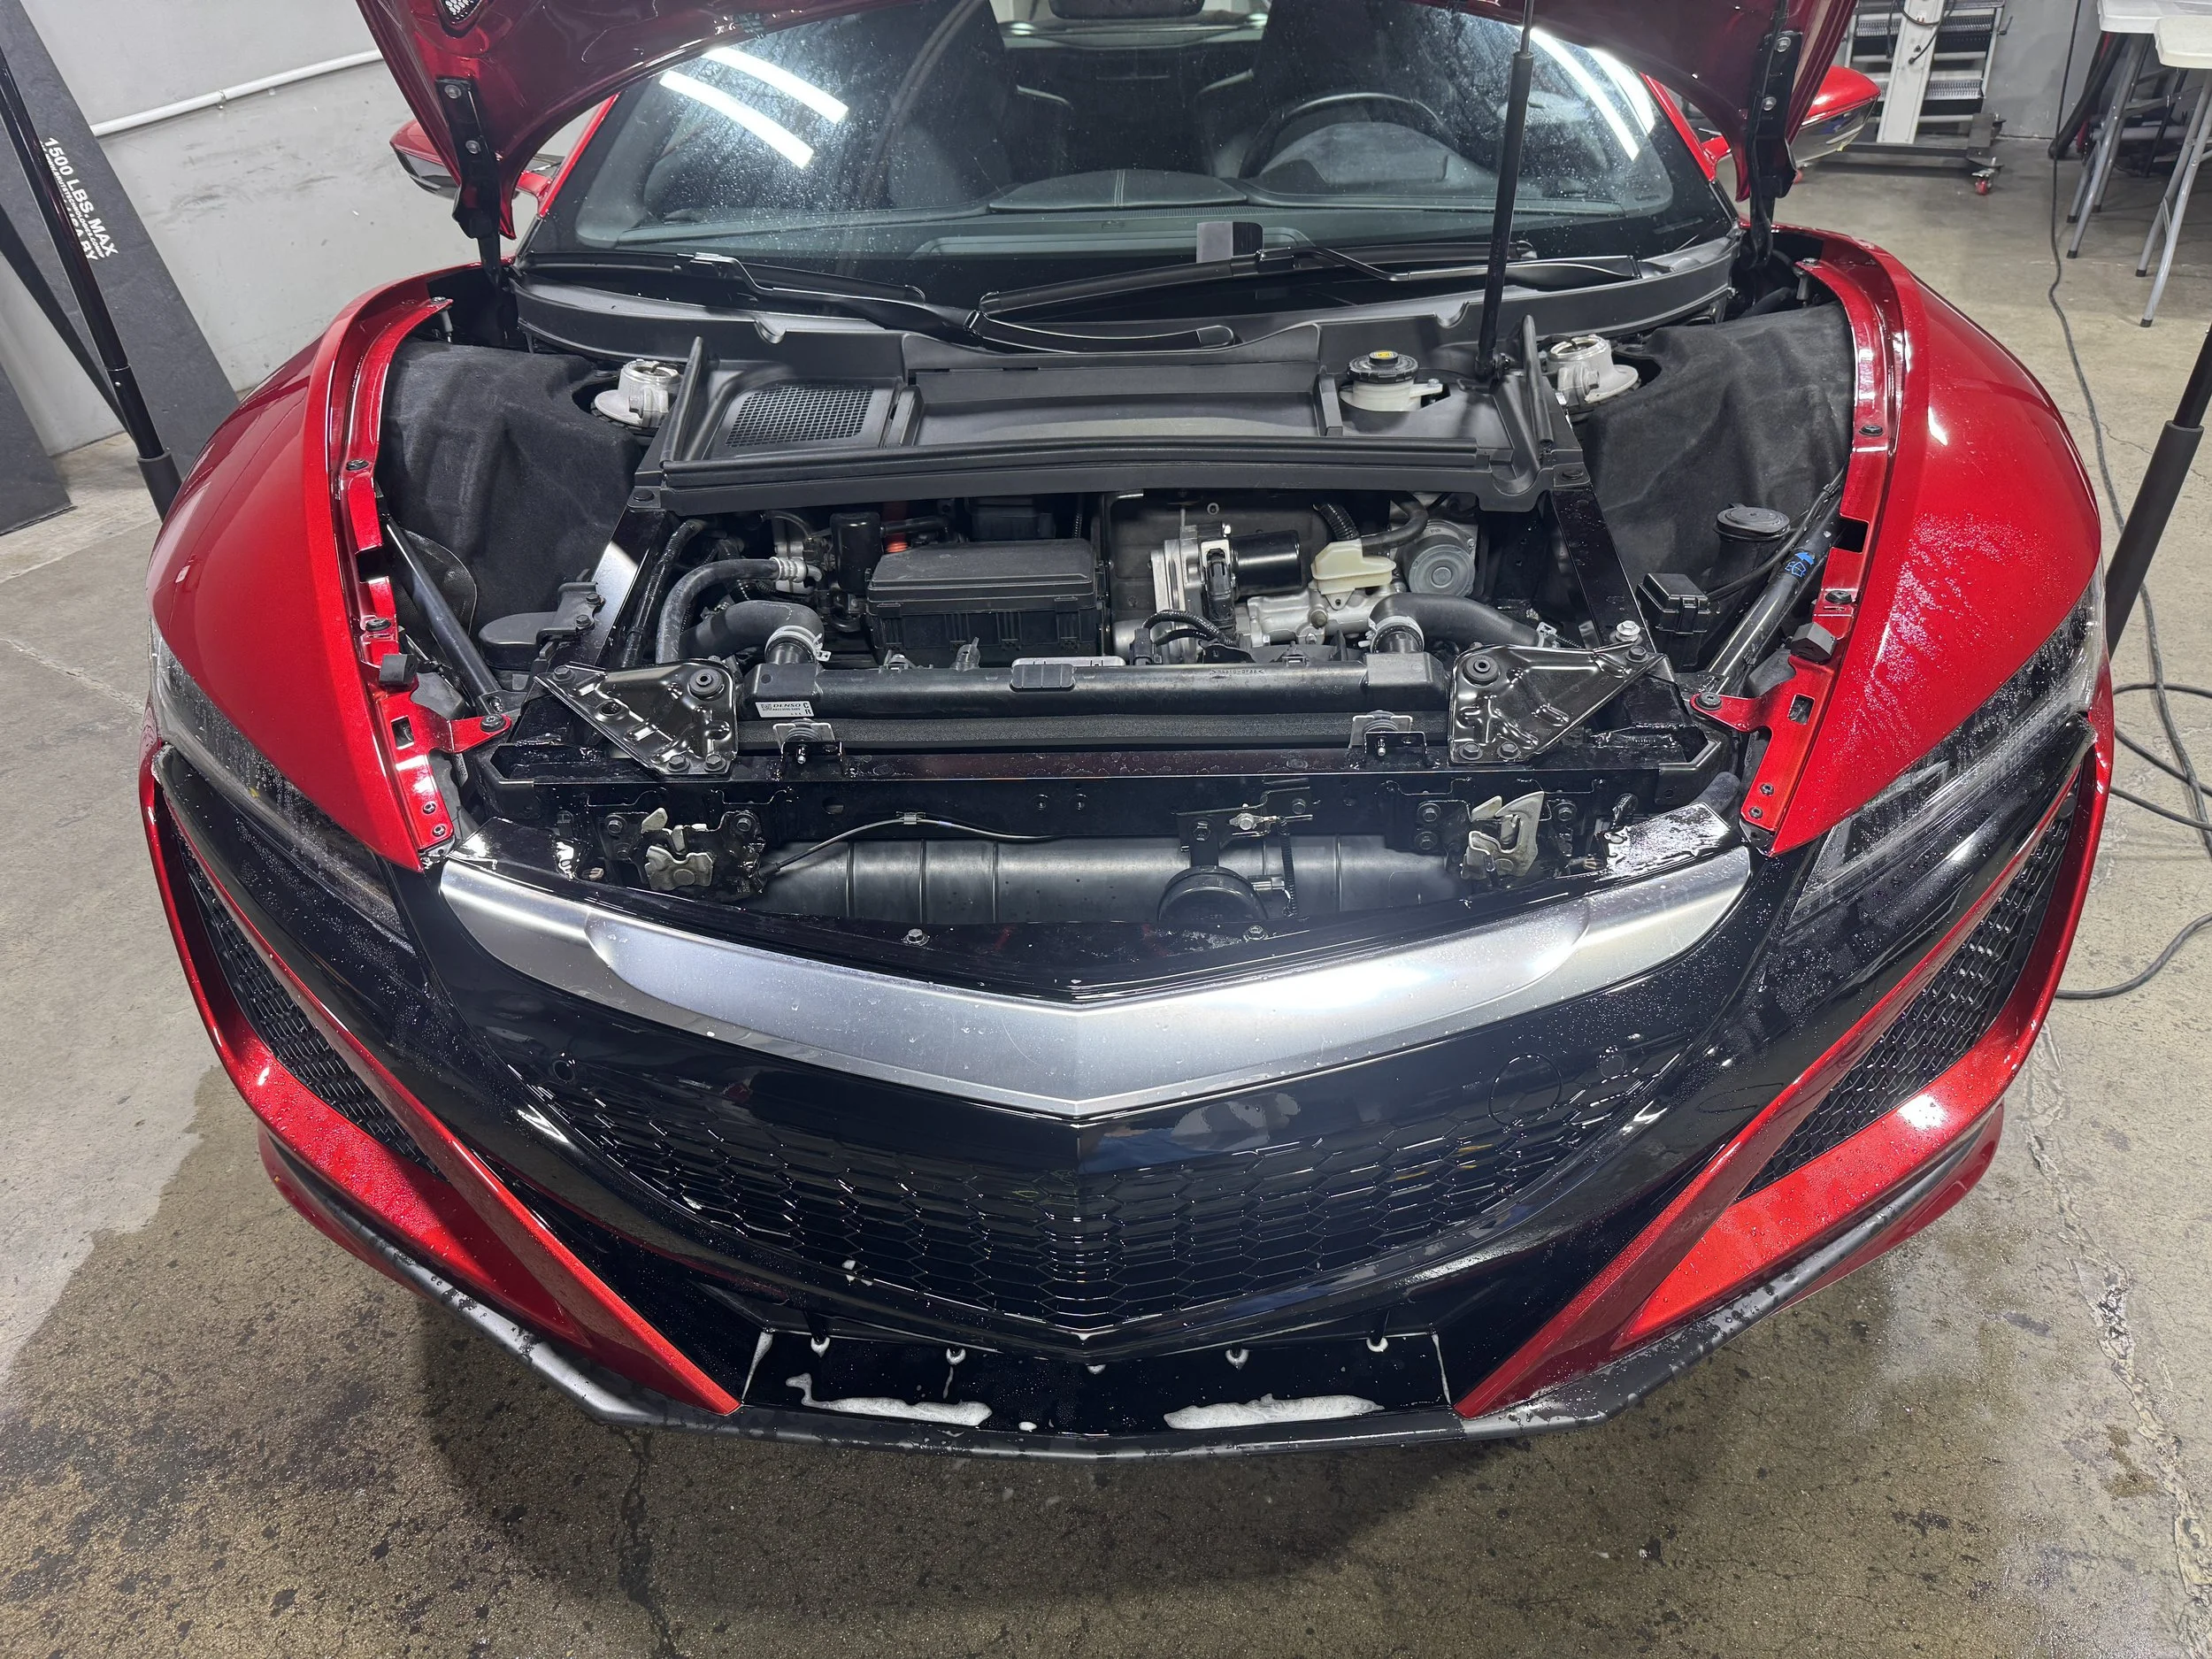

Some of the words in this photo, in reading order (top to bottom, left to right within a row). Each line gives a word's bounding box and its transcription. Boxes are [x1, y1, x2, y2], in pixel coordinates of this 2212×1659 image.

[45, 137, 73, 175] 1500
[66, 179, 95, 219] LBS.
[88, 219, 119, 257] MAX
